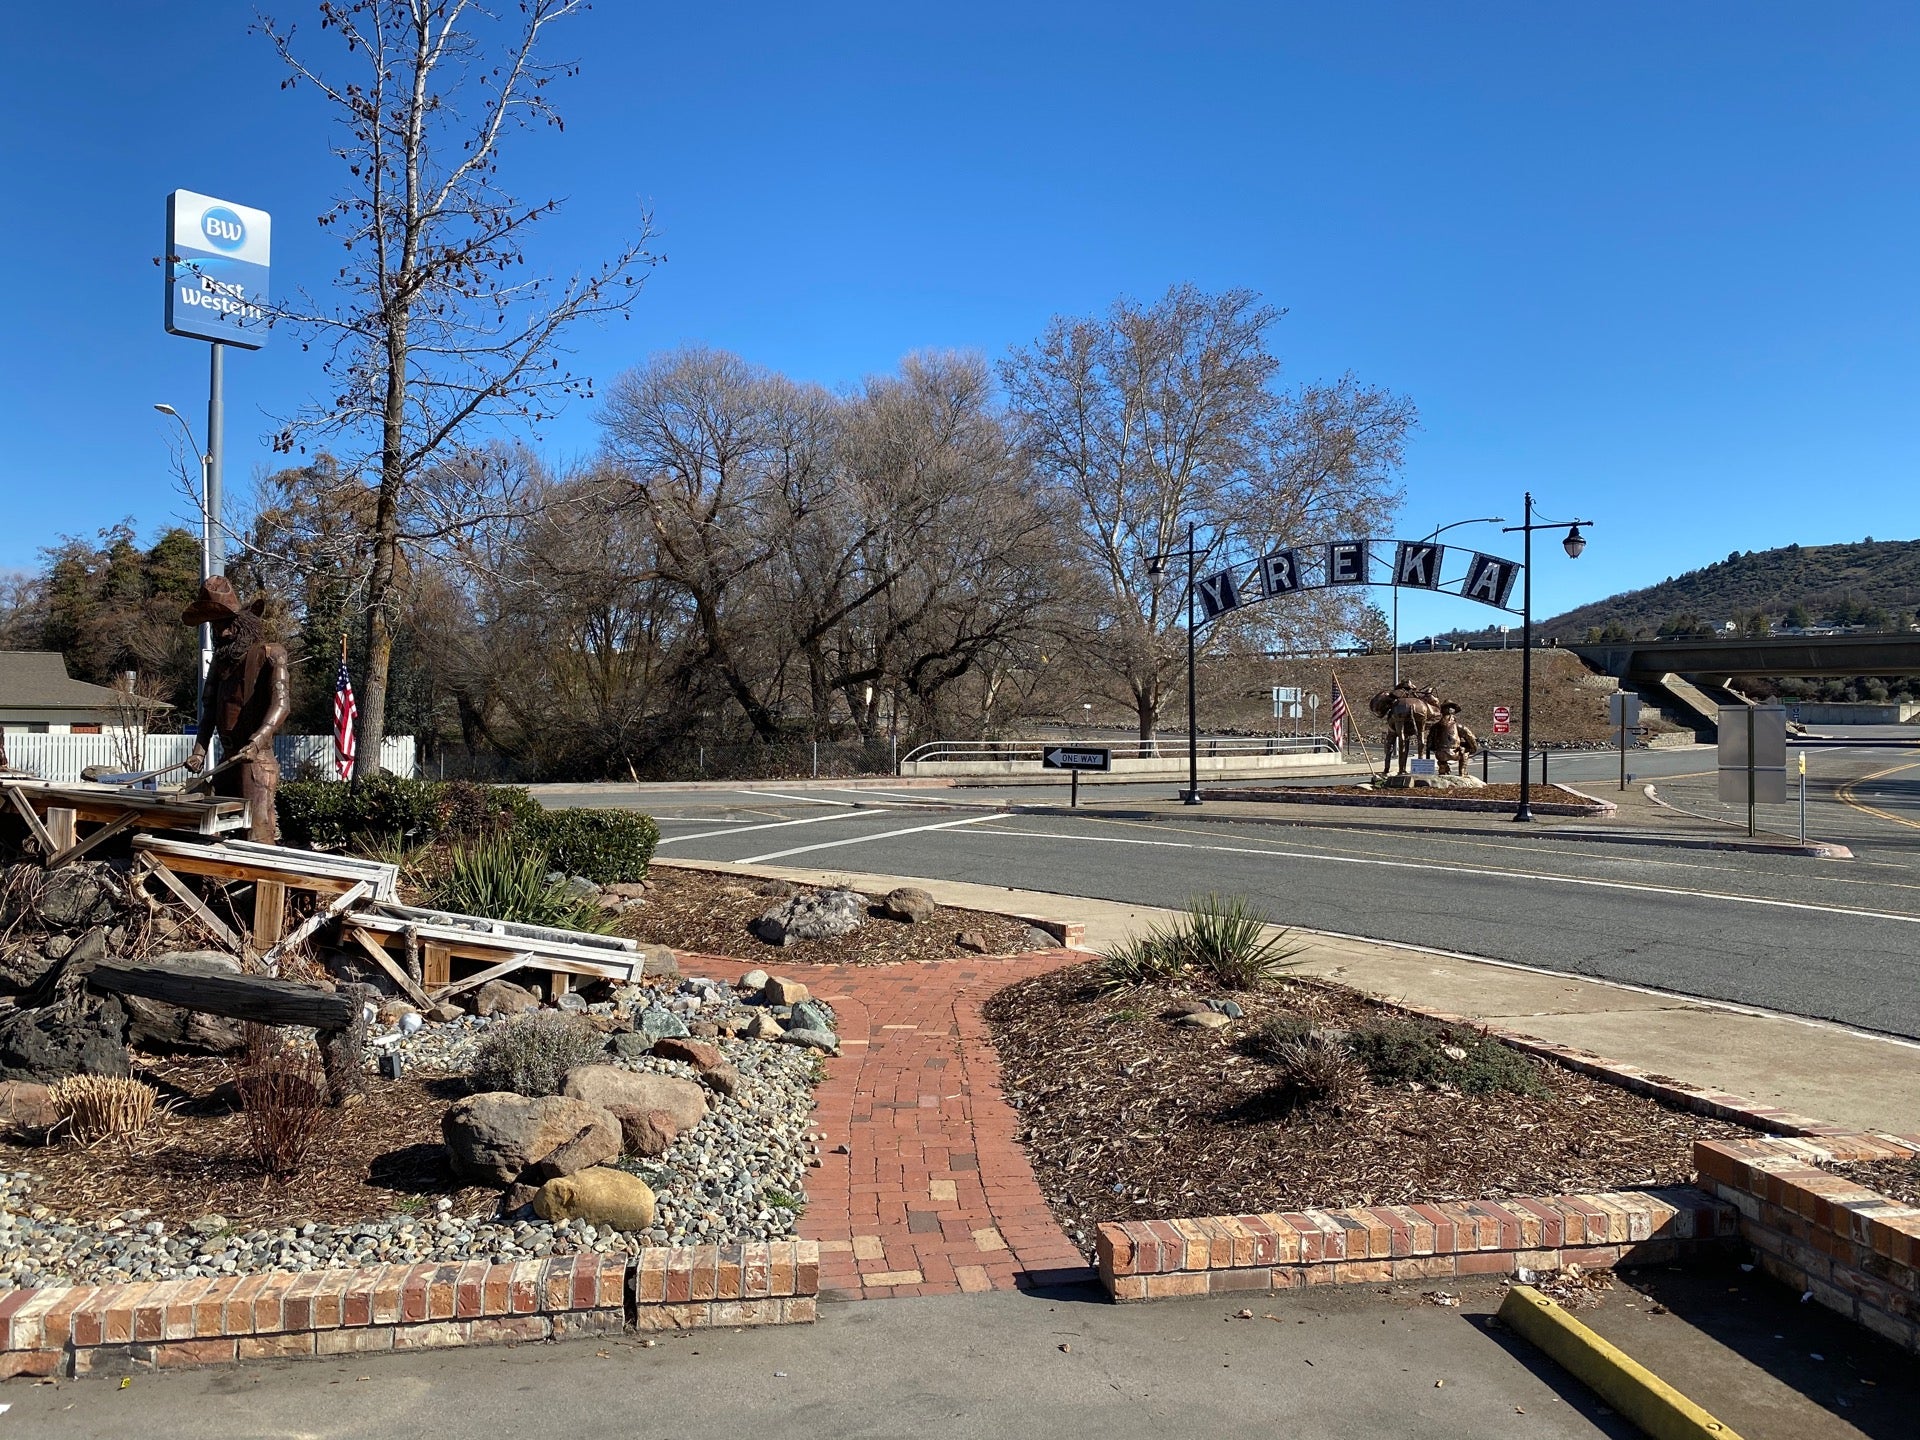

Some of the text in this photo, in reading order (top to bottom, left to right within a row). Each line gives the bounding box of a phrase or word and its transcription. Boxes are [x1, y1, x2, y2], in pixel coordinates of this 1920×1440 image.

[206, 217, 242, 241] BW
[201, 274, 245, 299] Best
[181, 287, 264, 320] Western
[1201, 545, 1501, 611] YREKA
[1062, 754, 1098, 763] ONE WAY
